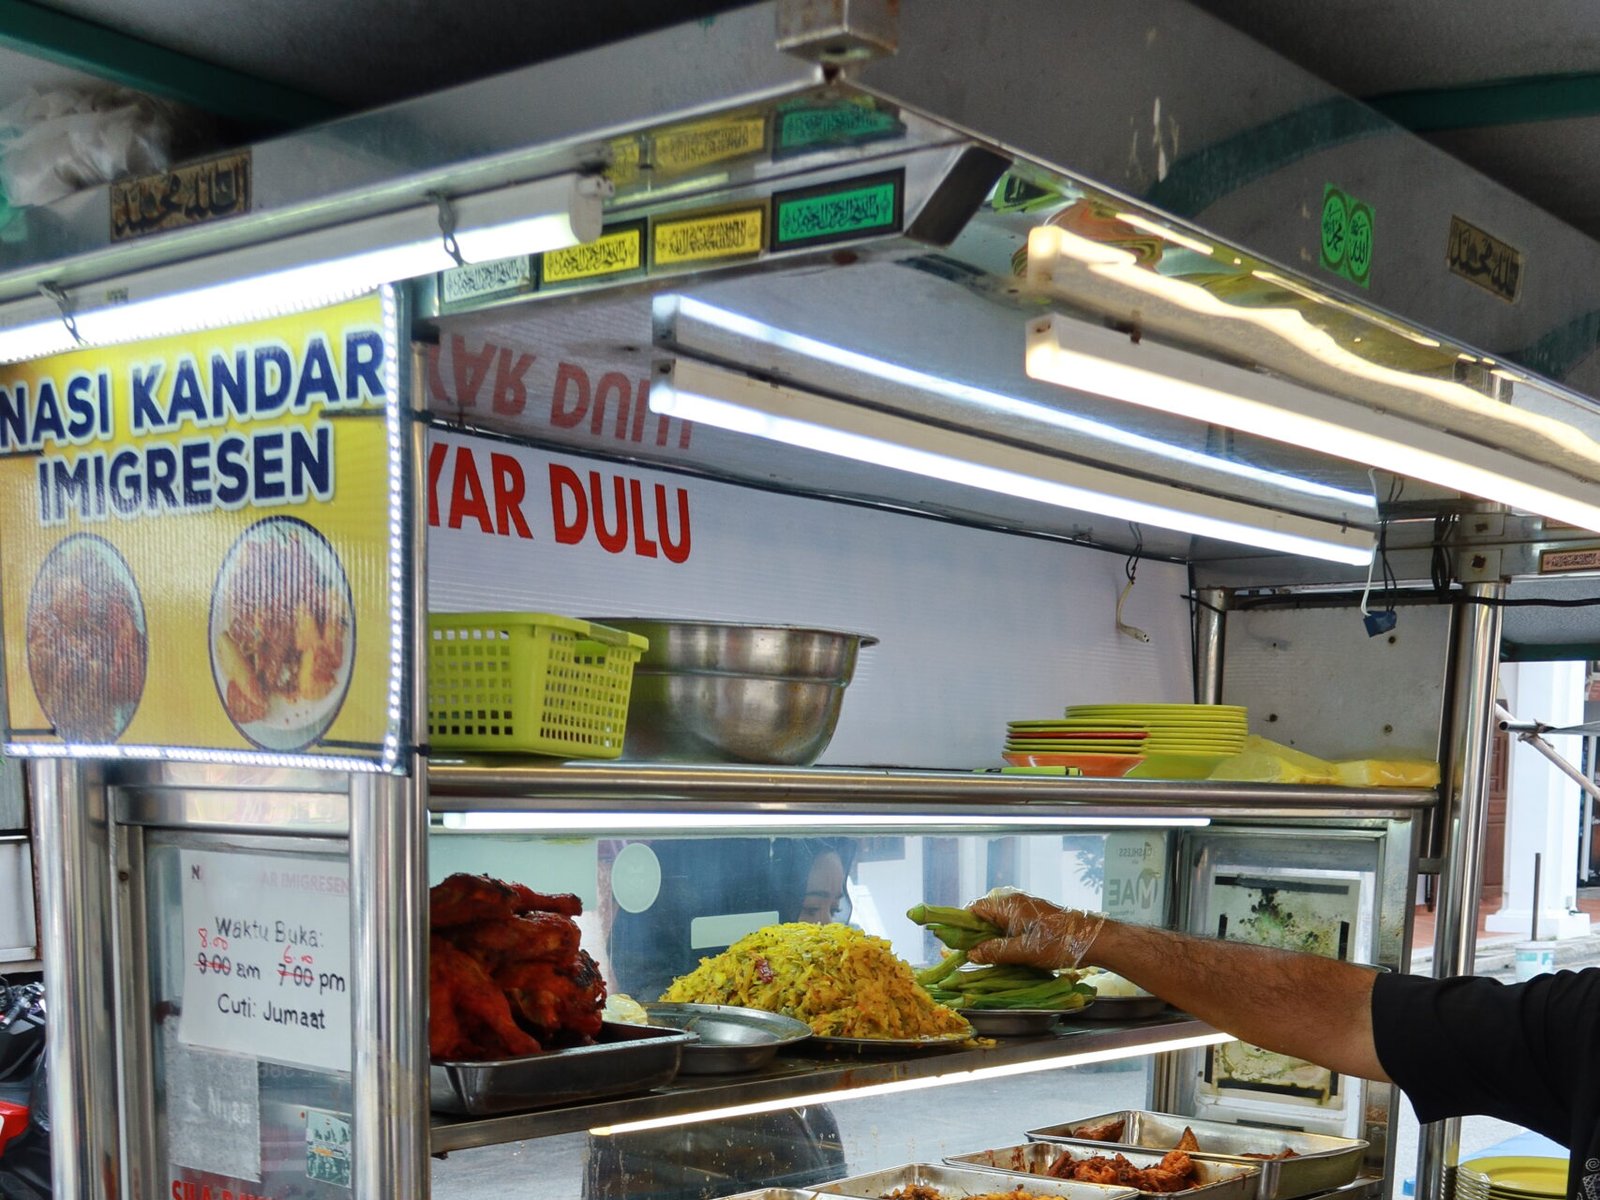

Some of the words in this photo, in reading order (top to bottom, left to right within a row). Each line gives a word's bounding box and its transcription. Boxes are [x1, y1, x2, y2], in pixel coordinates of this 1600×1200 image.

[0, 373, 110, 449] NASI
[132, 329, 388, 429] KANDAR
[38, 427, 331, 522] IMIGRESEN
[549, 462, 692, 564] DULU
[216, 917, 269, 942] Waktu
[217, 993, 256, 1018] Cuti:
[263, 1001, 325, 1029] Jumaat
[236, 962, 261, 979] am
[320, 973, 346, 995] pm
